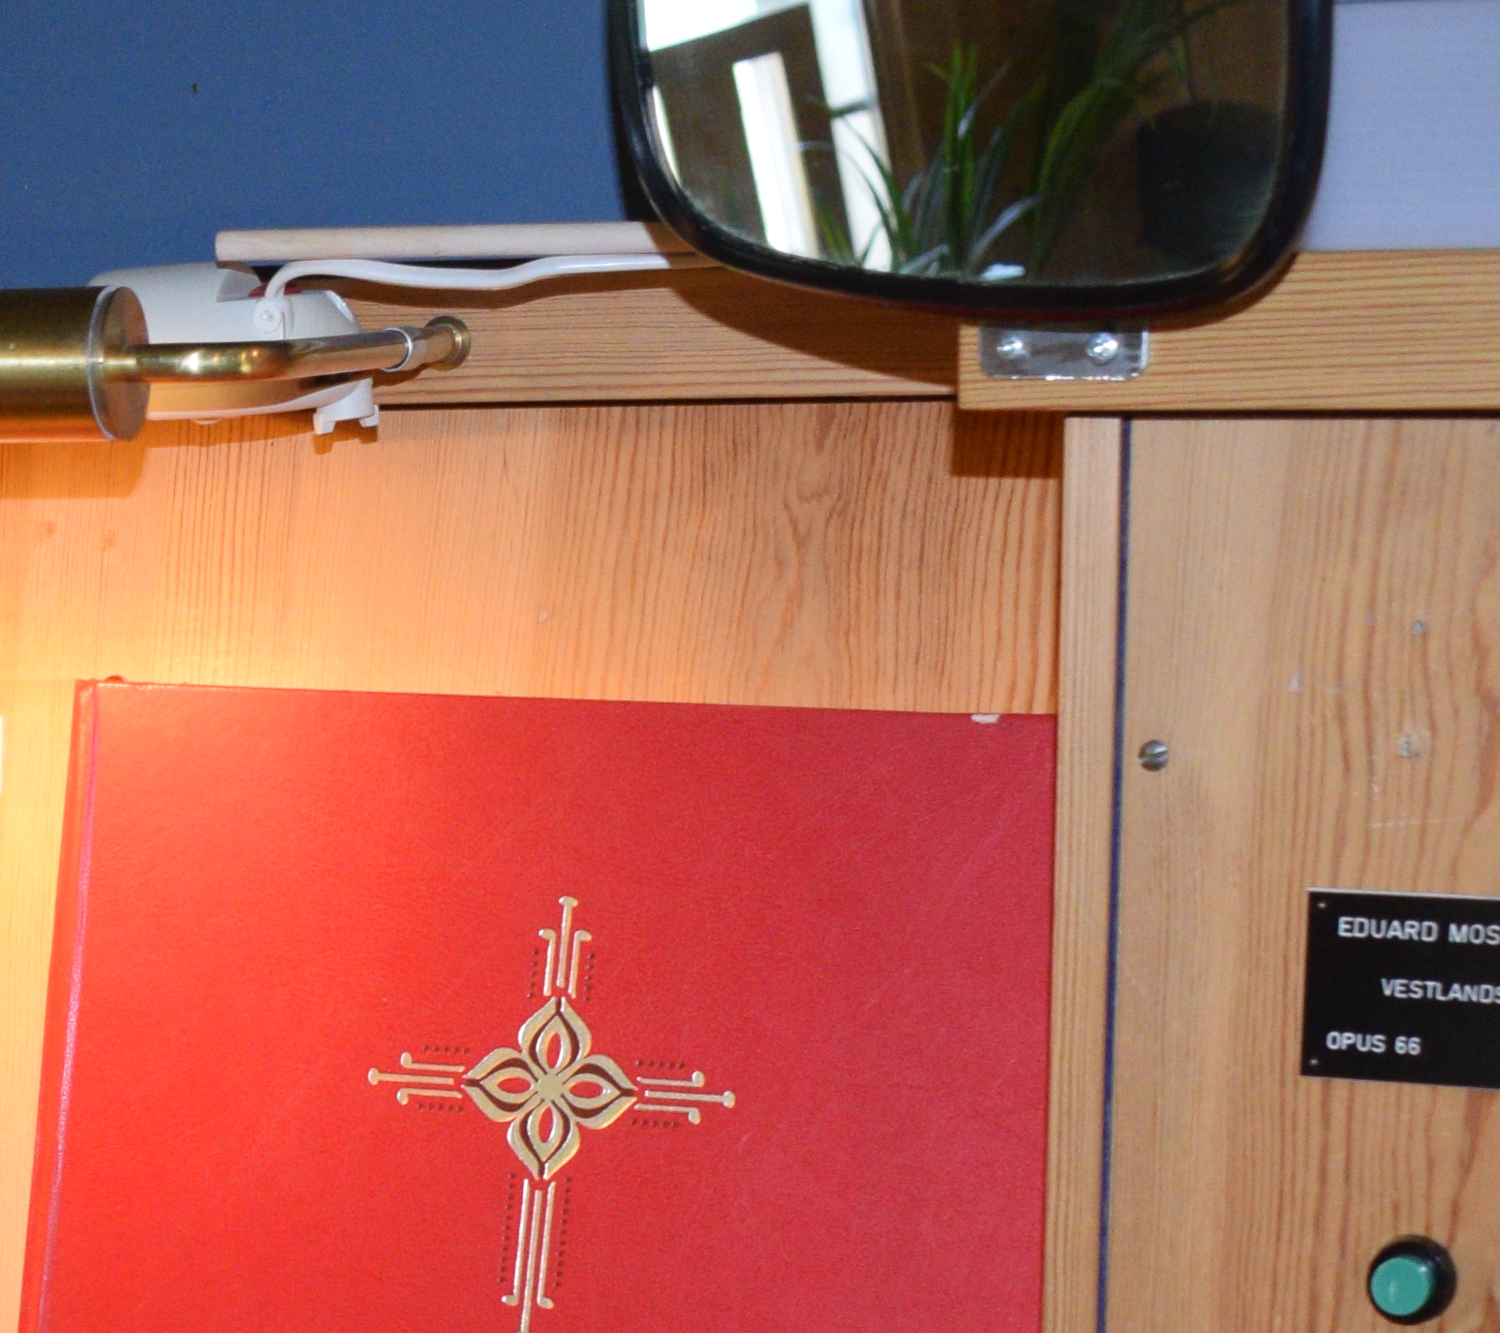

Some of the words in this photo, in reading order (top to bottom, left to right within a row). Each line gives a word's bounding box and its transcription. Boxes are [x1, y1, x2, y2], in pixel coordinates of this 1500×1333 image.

[1337, 916, 1438, 942] EDUARD
[1326, 1031, 1386, 1054] OPUS
[1394, 1035, 1421, 1056] 66
